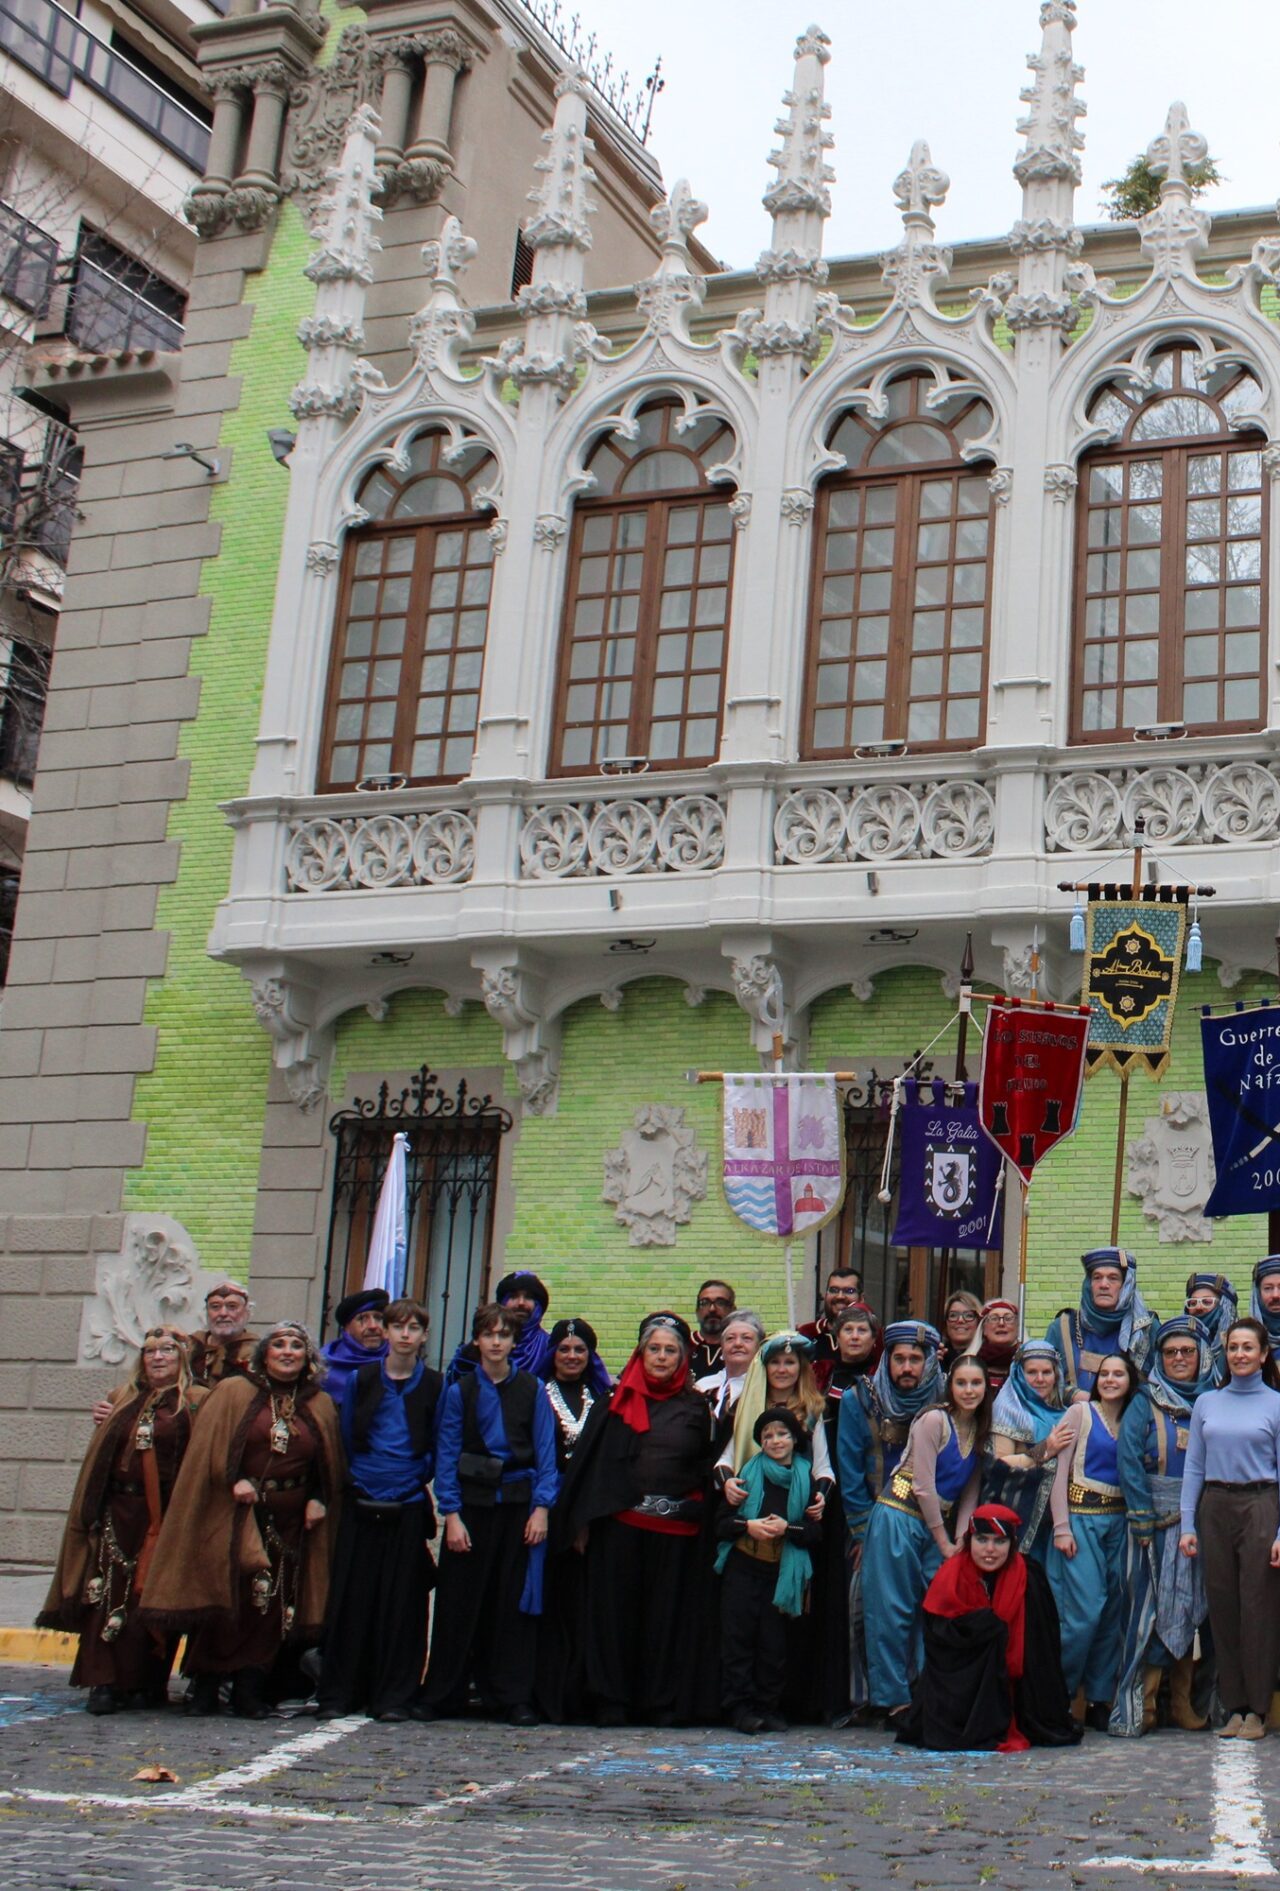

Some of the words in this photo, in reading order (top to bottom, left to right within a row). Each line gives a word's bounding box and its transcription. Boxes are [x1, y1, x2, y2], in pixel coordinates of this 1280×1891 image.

[1253, 1044, 1273, 1067] de
[924, 1120, 945, 1136] La
[946, 1121, 979, 1143] Galia
[724, 1163, 783, 1175] ALKAZAR
[958, 1215, 987, 1238] 2001
